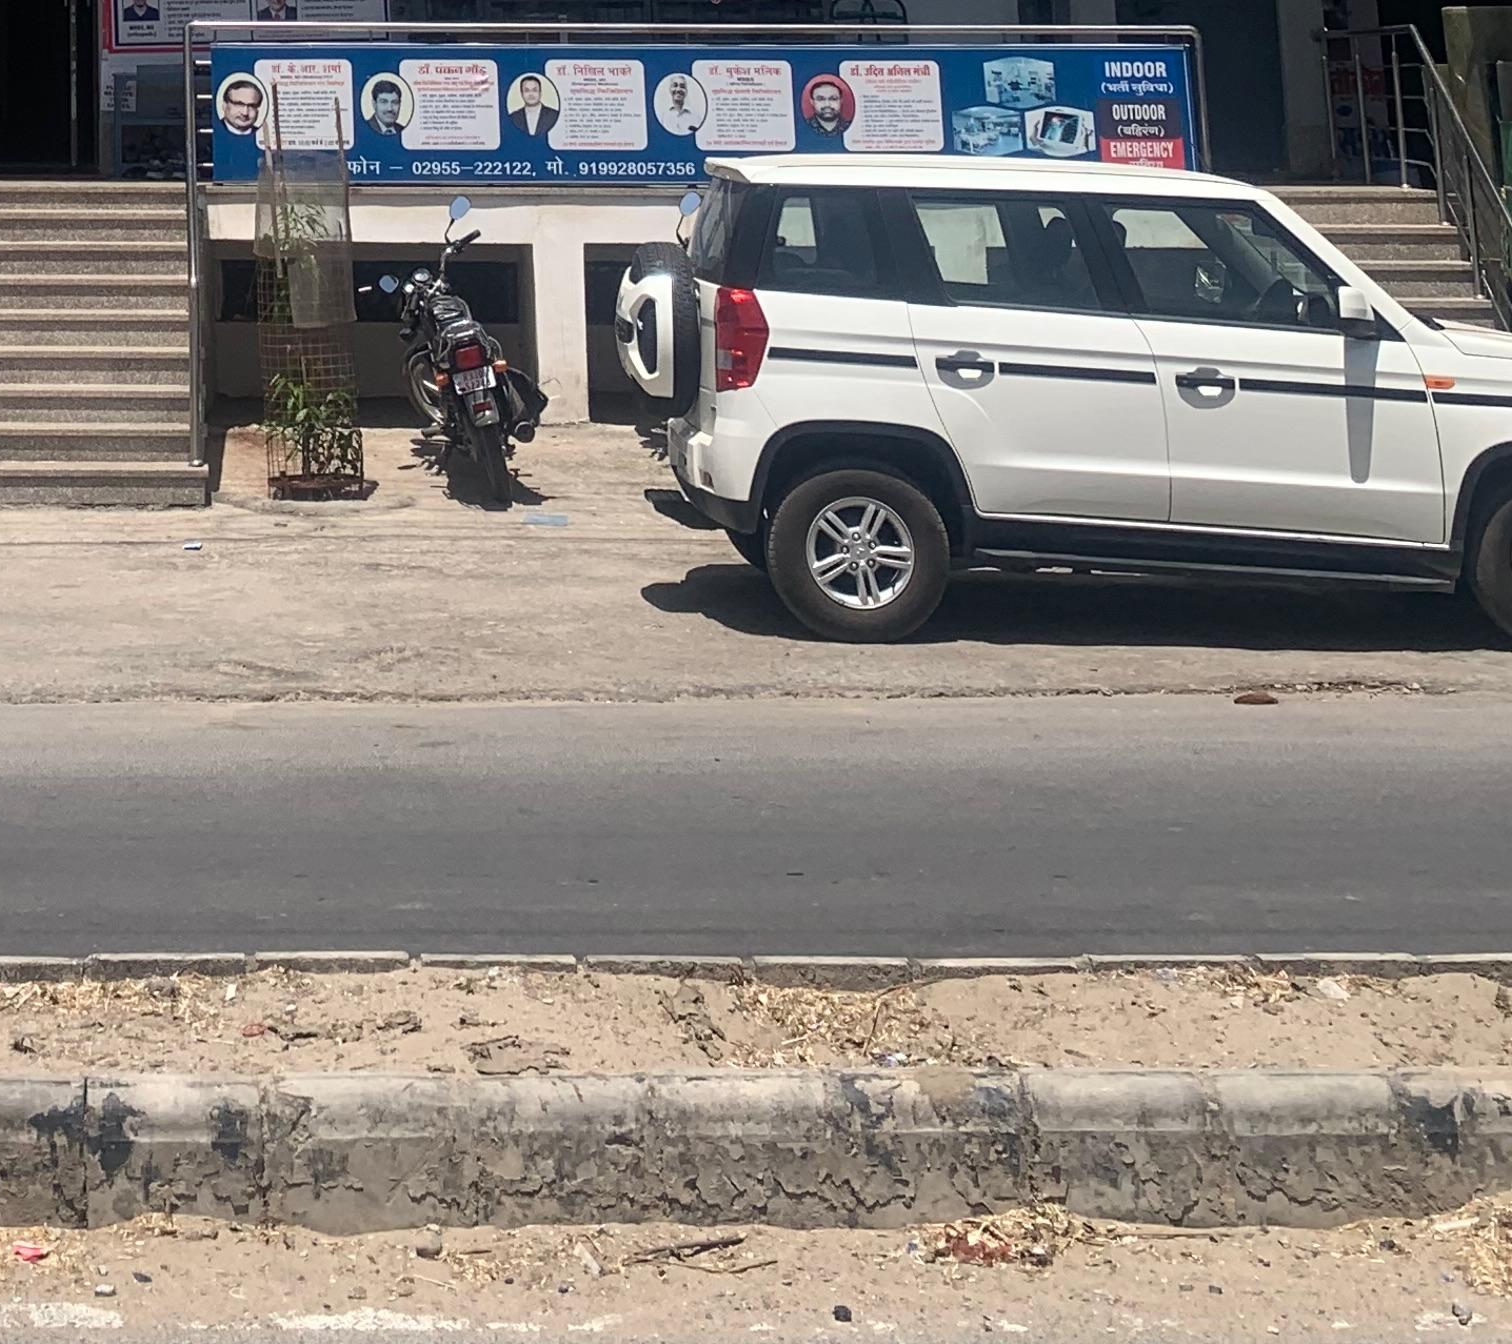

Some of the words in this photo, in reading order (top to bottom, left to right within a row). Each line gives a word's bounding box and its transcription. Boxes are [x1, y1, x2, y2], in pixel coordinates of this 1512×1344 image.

[573, 63, 605, 76] निखिल
[726, 64, 751, 78] मुकेश
[850, 65, 863, 77] डॉ.
[864, 64, 885, 78] उदित
[888, 64, 912, 77] अनिल
[1104, 61, 1167, 78] INDOOR
[1130, 80, 1174, 96] सुविधा)
[1112, 104, 1166, 121] OUTDOOR
[1109, 141, 1174, 158] EMERGENCY
[347, 155, 381, 176] फोन
